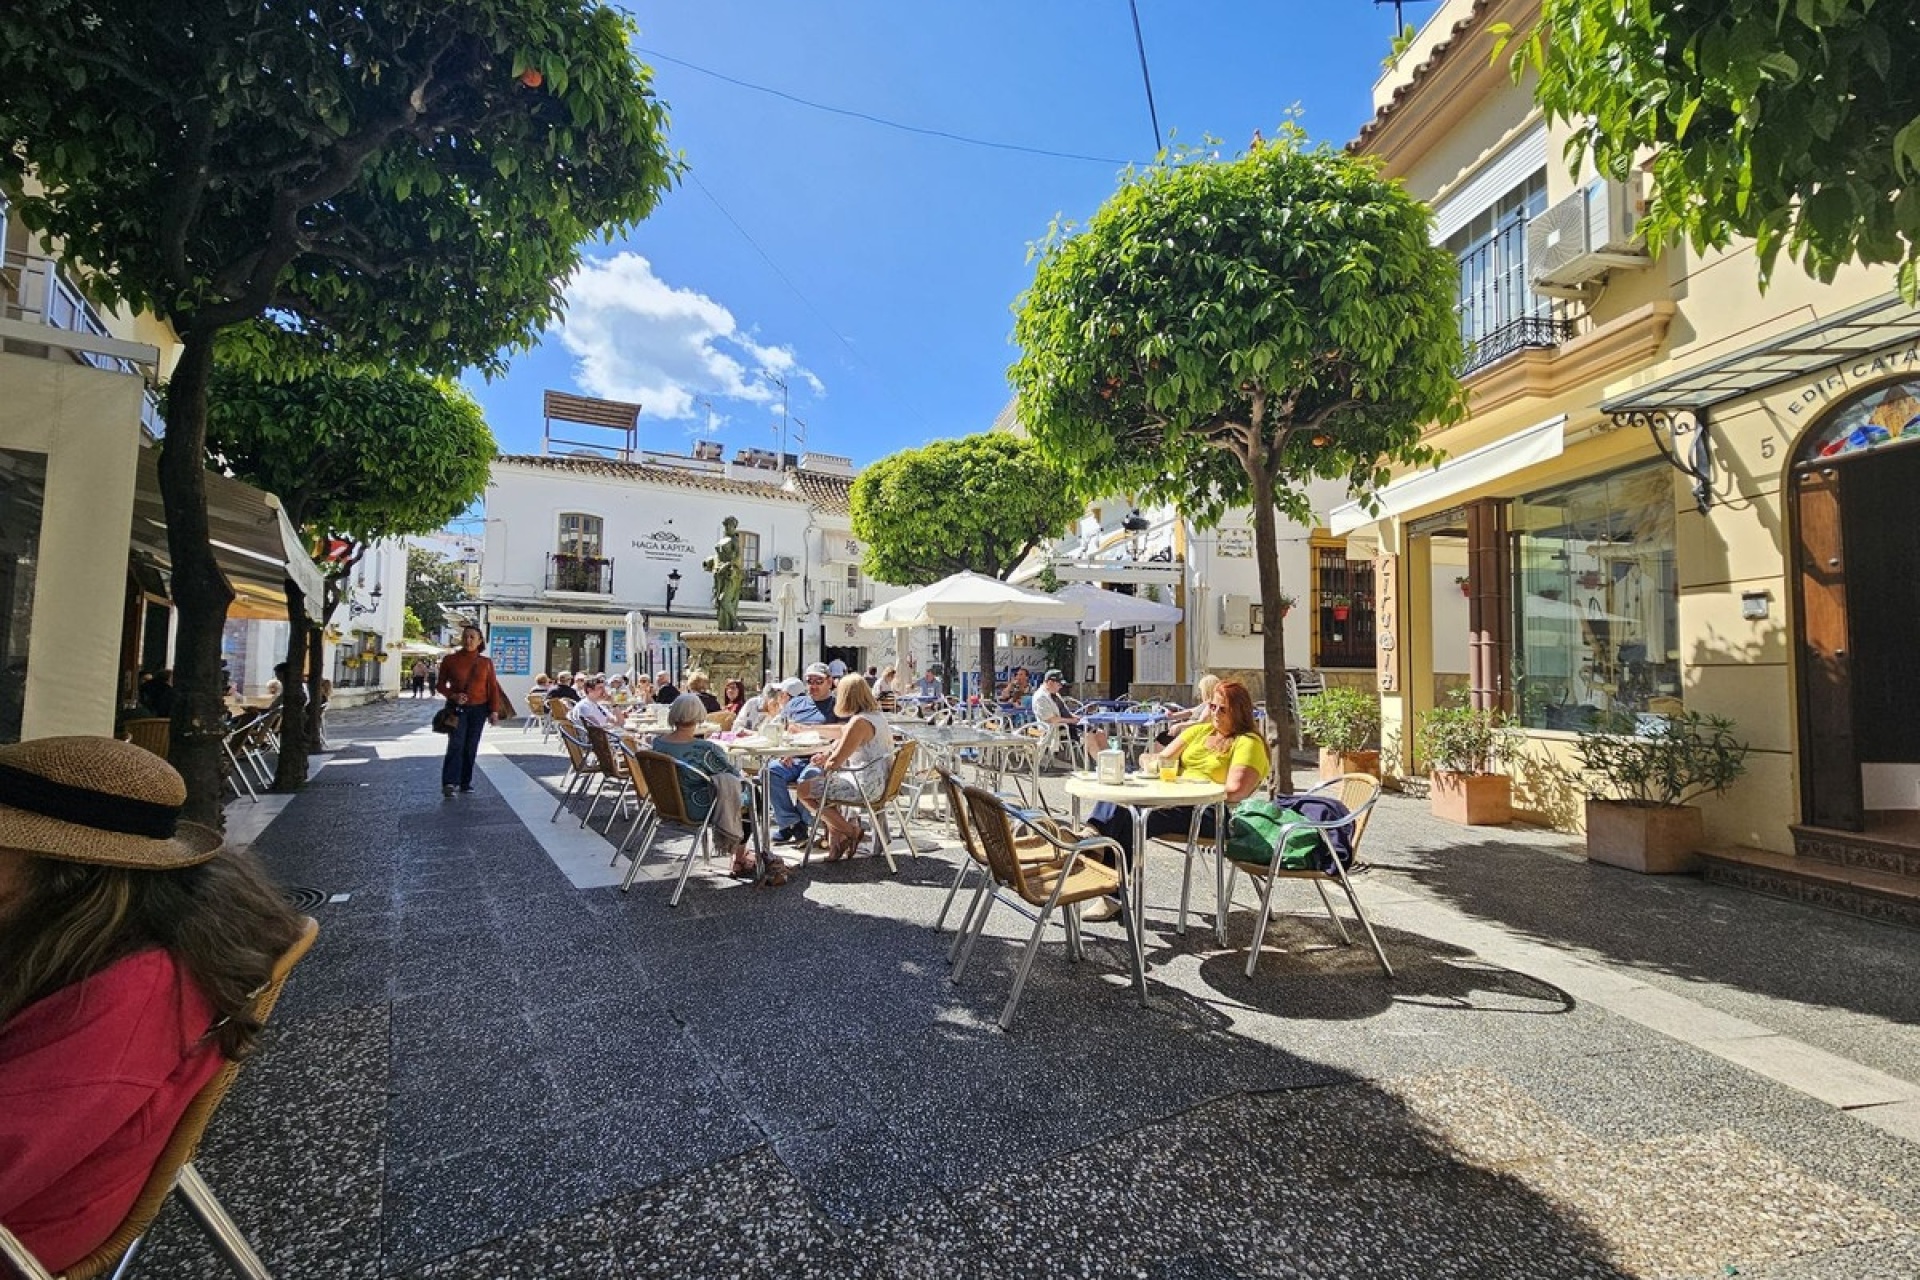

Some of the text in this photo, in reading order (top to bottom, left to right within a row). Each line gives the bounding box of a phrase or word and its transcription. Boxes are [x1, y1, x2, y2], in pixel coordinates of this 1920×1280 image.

[1760, 436, 1775, 459] 5
[631, 540, 659, 550] HAGA
[660, 543, 697, 554] KAPITAL
